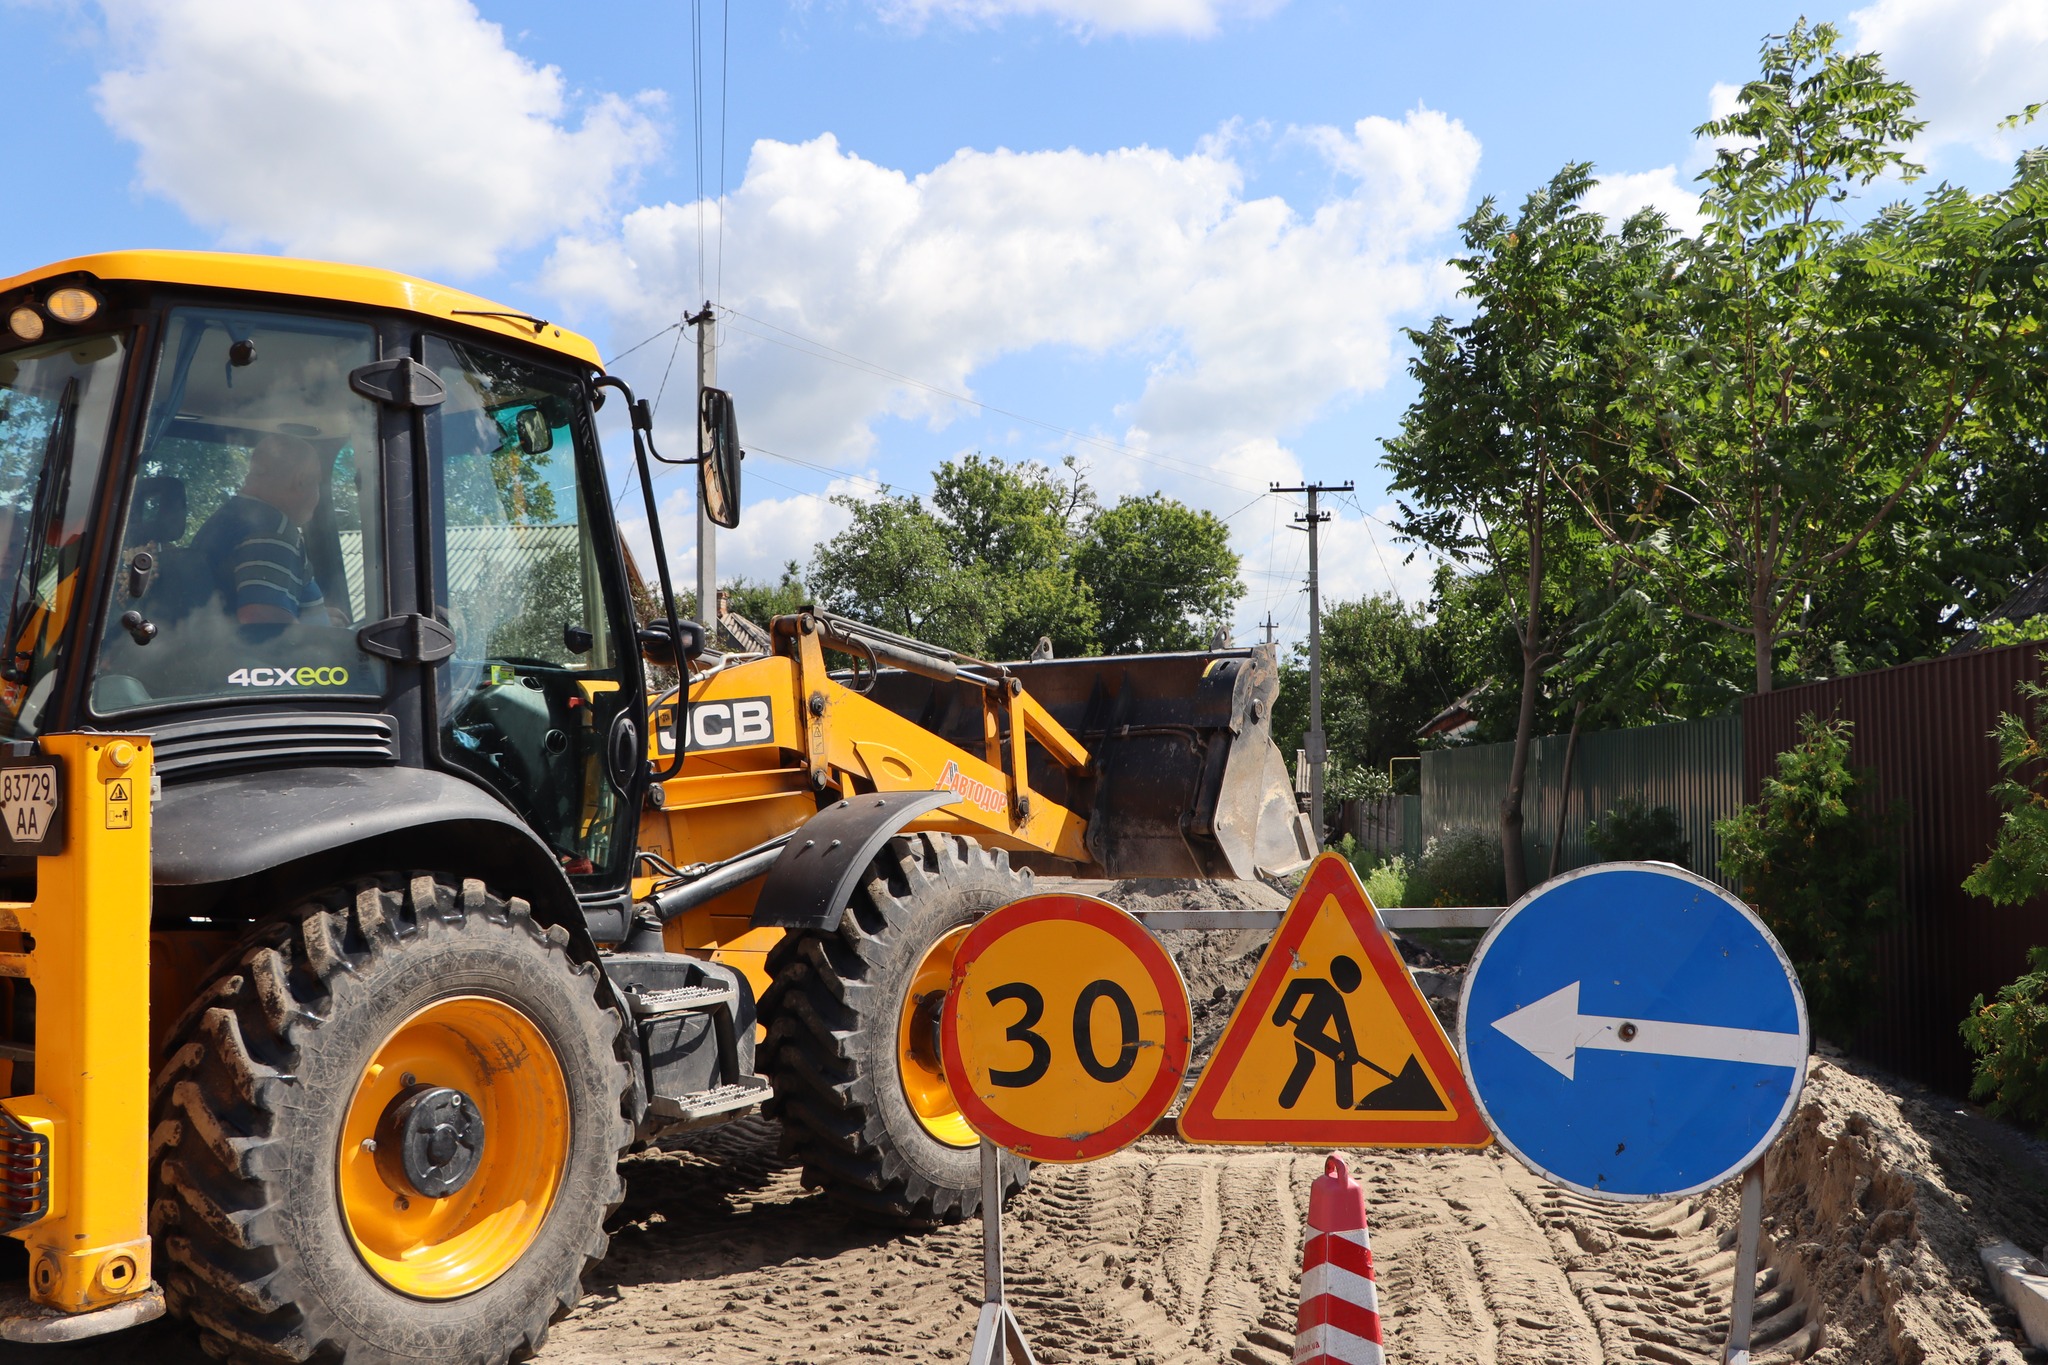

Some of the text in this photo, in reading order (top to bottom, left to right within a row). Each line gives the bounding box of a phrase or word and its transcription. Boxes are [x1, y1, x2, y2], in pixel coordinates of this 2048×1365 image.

[4, 773, 50, 802] 83729
[16, 806, 38, 835] AA
[986, 979, 1140, 1088] 30
